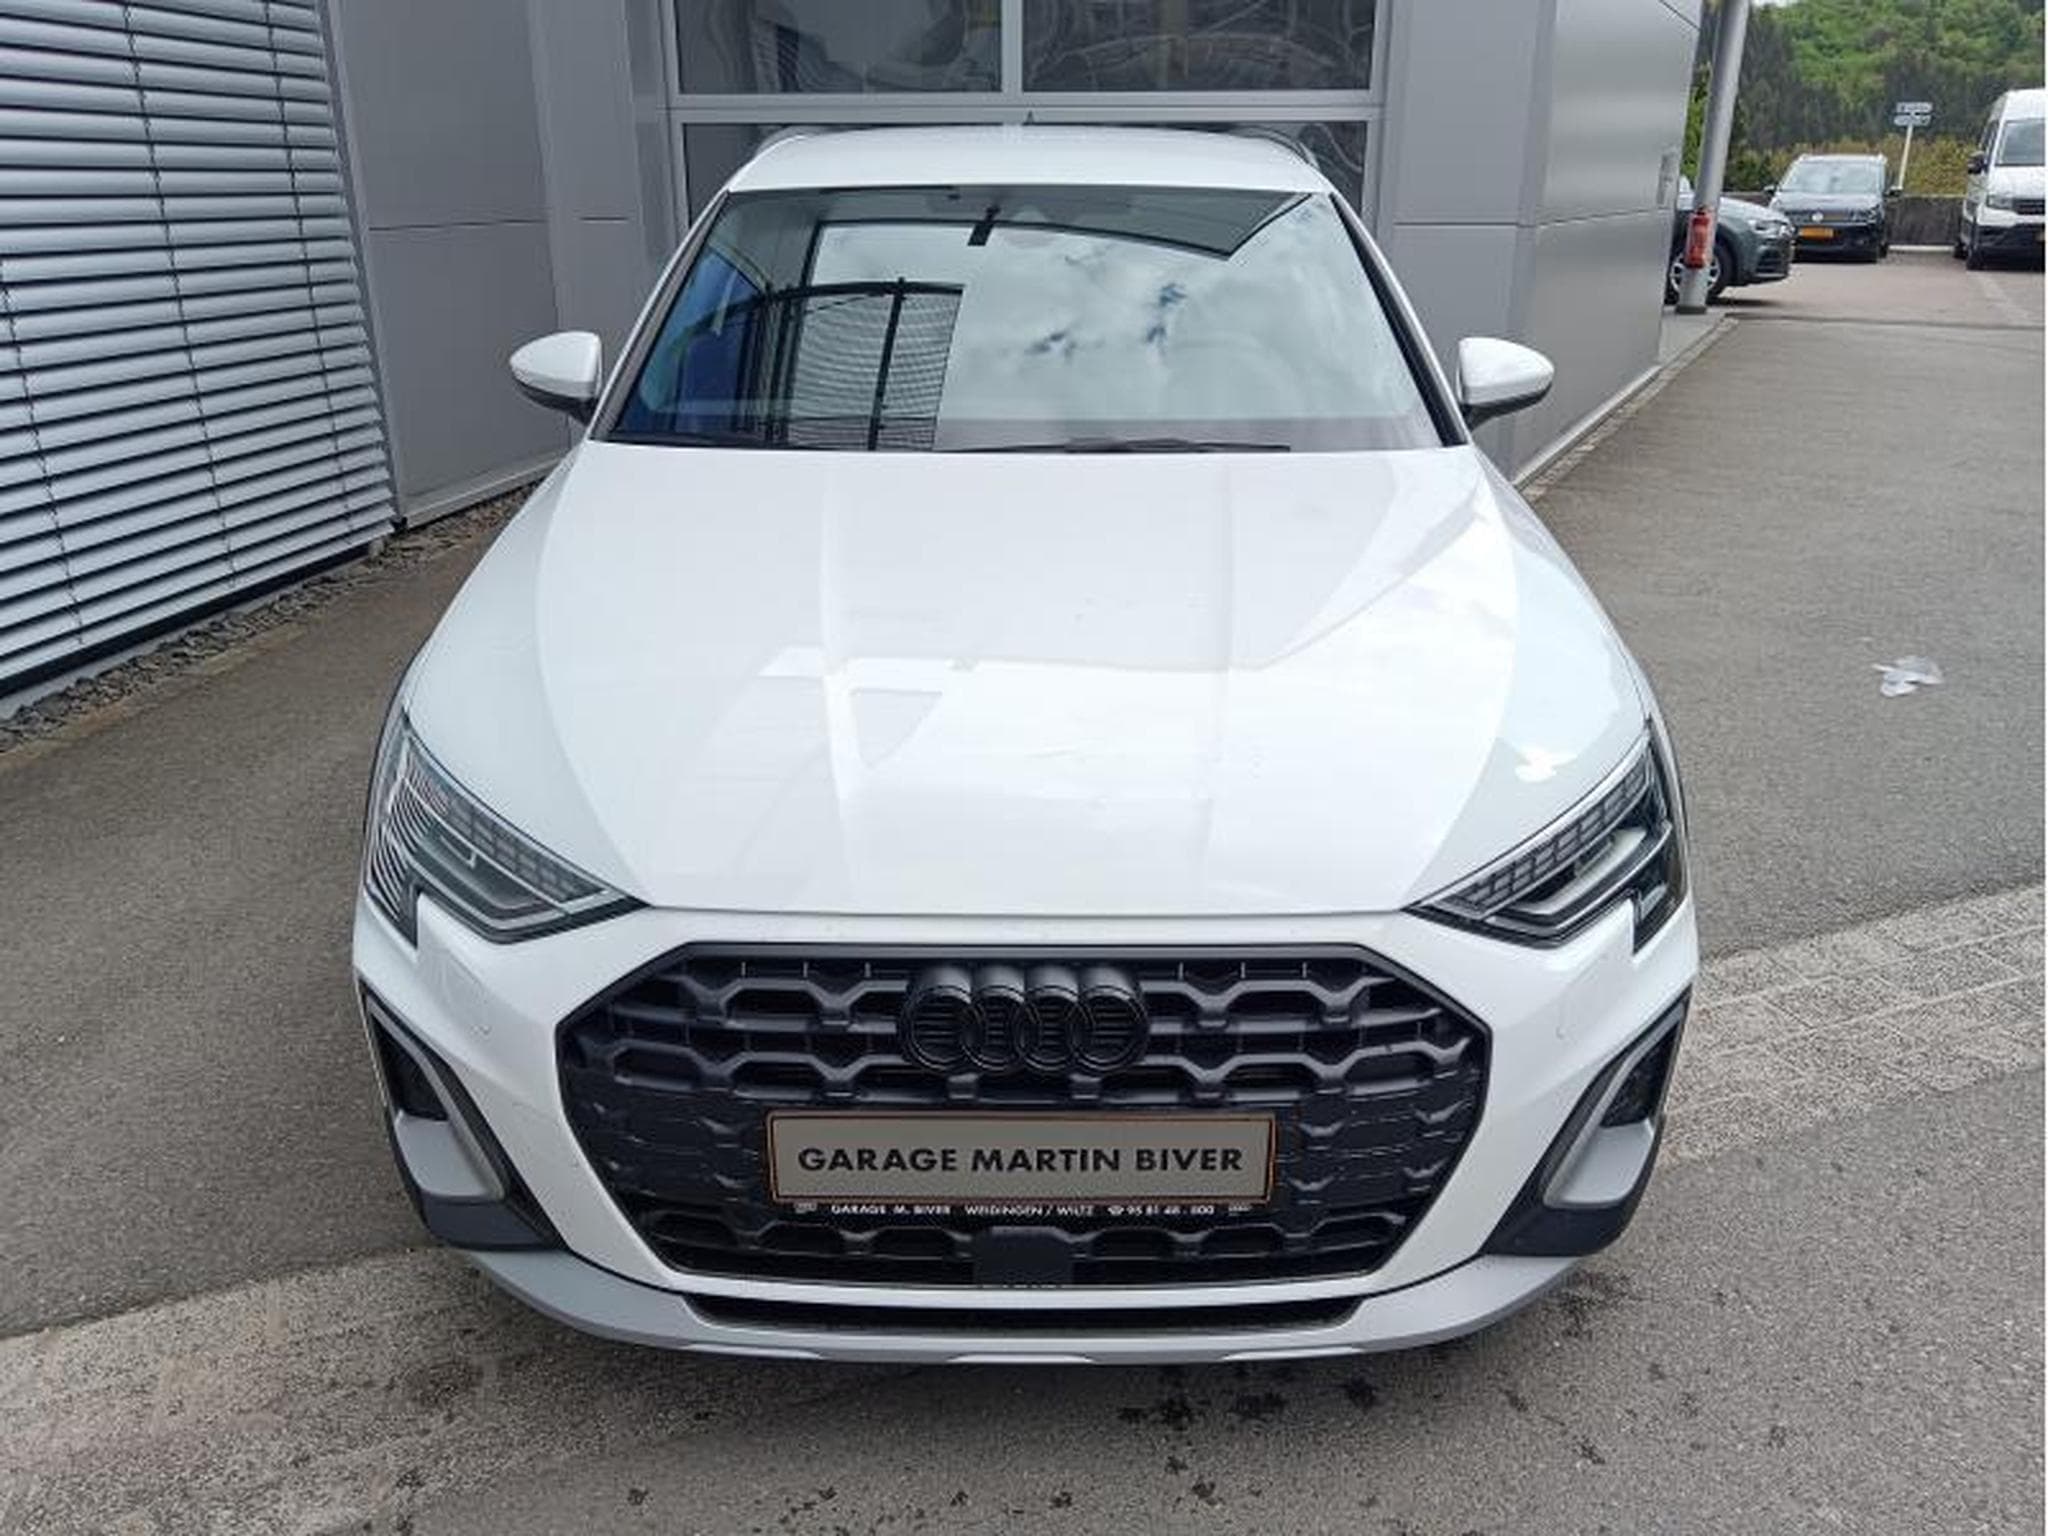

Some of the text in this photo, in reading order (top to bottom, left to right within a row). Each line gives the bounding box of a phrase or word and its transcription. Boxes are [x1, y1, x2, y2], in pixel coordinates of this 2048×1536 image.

[798, 1148, 1242, 1172] GARAGE MARTIN BIVER
[830, 1204, 887, 1215] GARAGE
[913, 1204, 952, 1215] BIVER
